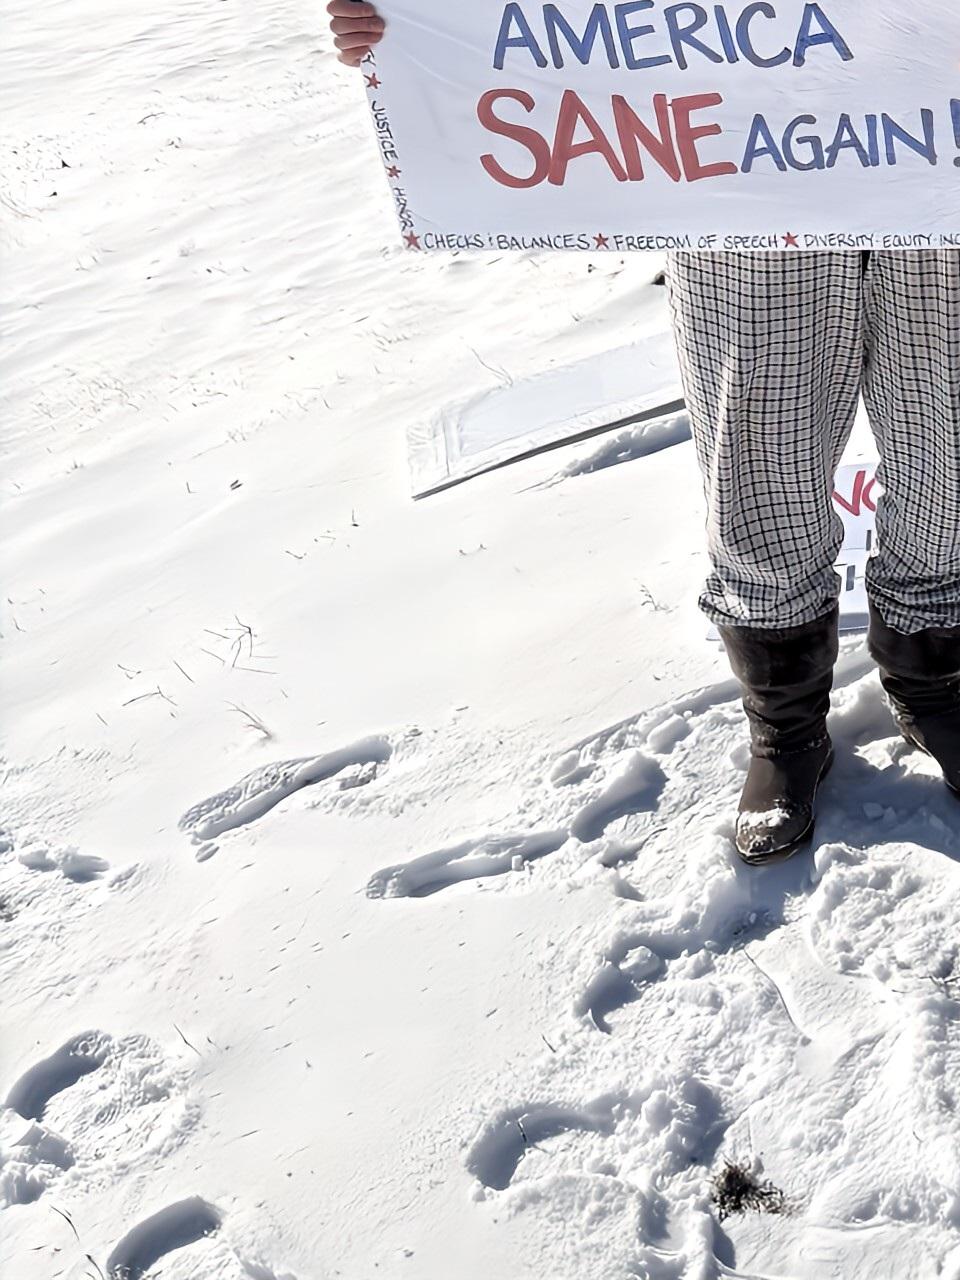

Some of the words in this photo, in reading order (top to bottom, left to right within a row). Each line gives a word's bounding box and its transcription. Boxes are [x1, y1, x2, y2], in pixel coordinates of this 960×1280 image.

[493, 0, 855, 71] AMERICA
[371, 100, 399, 162] JUSTICE
[477, 88, 738, 189] SANE
[424, 232, 485, 250] CHECKS
[496, 234, 590, 251] BALANCES
[613, 234, 691, 251] FREEDOM
[697, 234, 717, 250] OF
[723, 234, 778, 250] SPEECH
